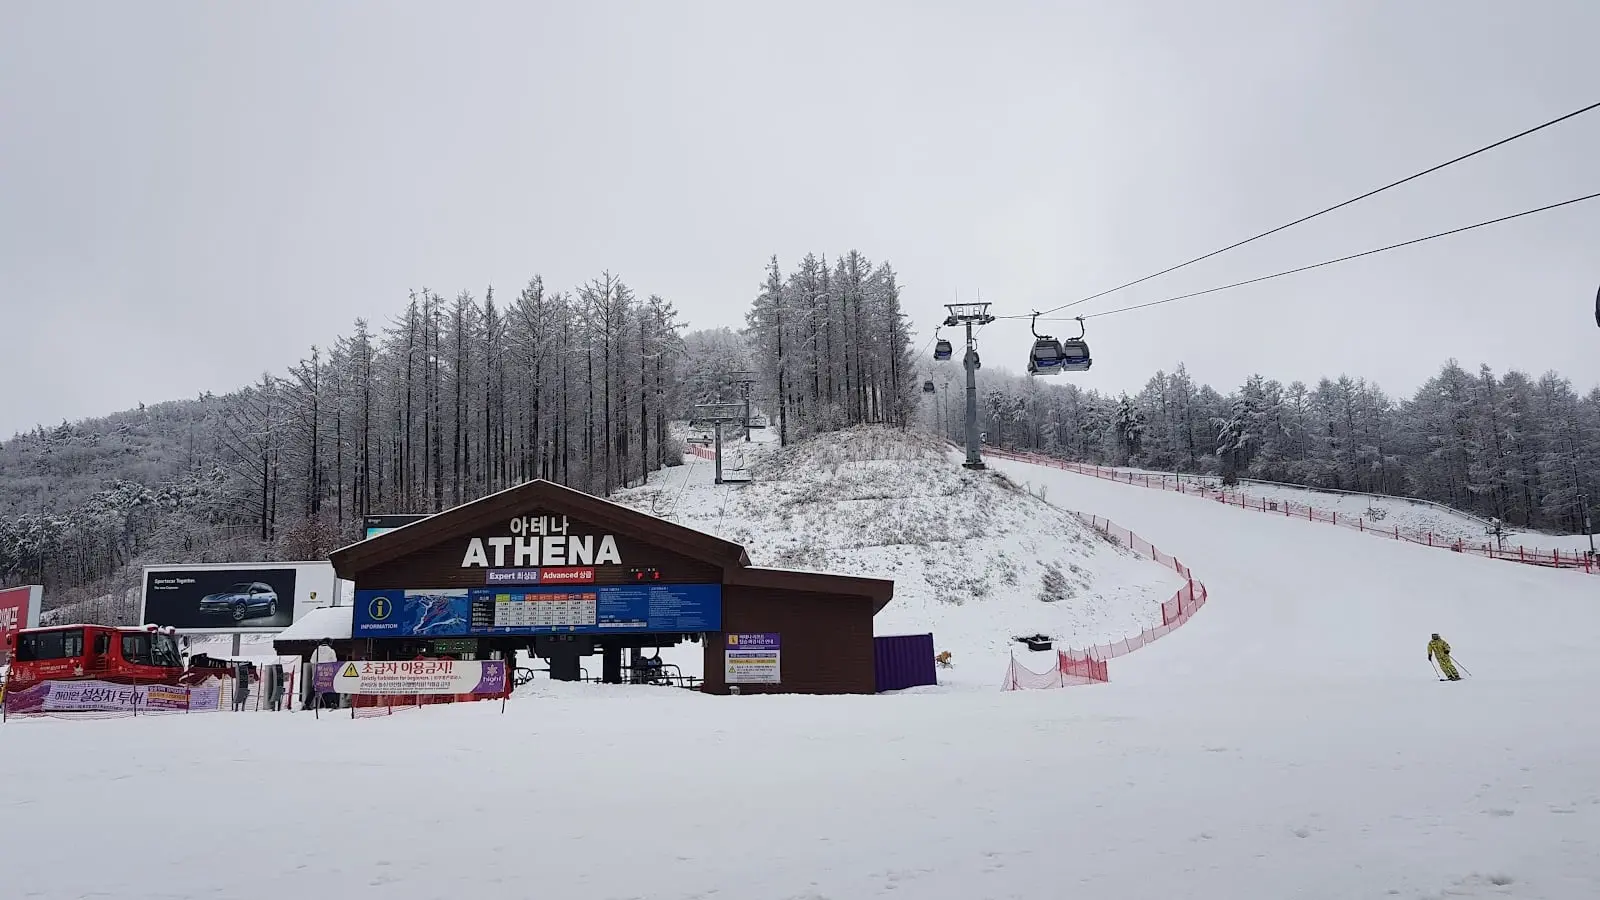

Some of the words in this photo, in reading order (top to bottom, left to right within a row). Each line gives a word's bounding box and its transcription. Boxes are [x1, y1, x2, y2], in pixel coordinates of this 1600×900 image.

[510, 515, 569, 536] 아테나
[461, 535, 622, 567] ATHENA
[489, 572, 515, 580] Expert
[517, 571, 537, 580] 최상급
[543, 571, 578, 579] Advanced
[579, 570, 592, 579] 상급
[361, 662, 398, 674] 초급자
[401, 661, 453, 674] 이용금지!
[55, 691, 79, 700] 하이원
[80, 688, 116, 702] 설상차
[118, 691, 144, 705] 투어
